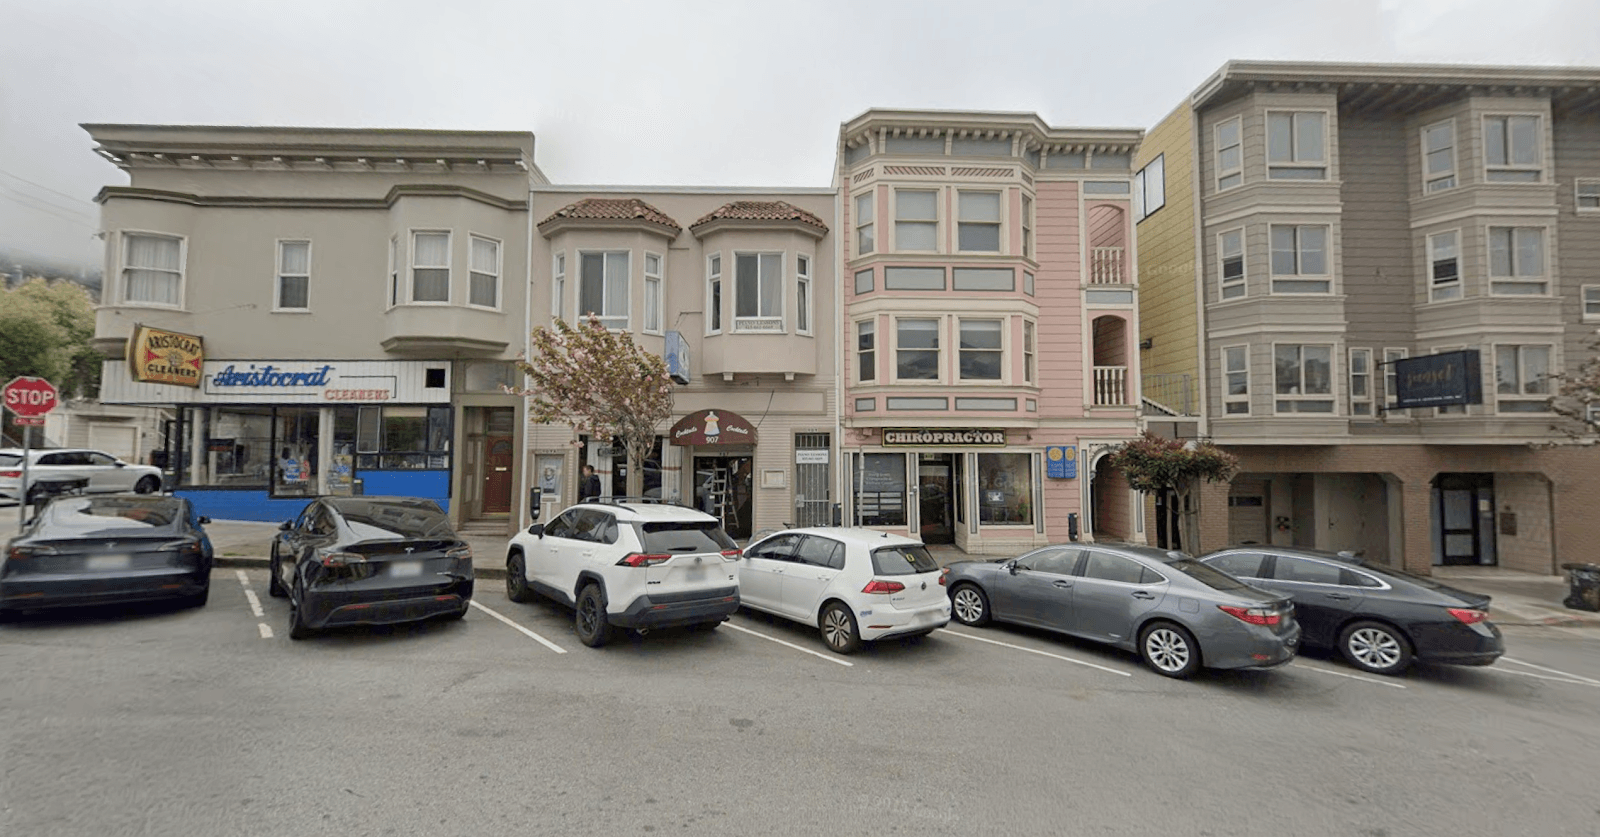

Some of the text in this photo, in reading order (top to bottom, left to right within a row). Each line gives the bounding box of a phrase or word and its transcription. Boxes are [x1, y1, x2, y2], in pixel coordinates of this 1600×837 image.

[147, 334, 200, 356] ARISTOCRAT
[147, 364, 197, 378] CLEANERS
[212, 364, 337, 387] Aristocrat
[6, 388, 55, 406] STOP
[324, 389, 391, 401] CLEANERS
[705, 436, 719, 444] 907
[884, 431, 1005, 444] CHIROPRACTOR
